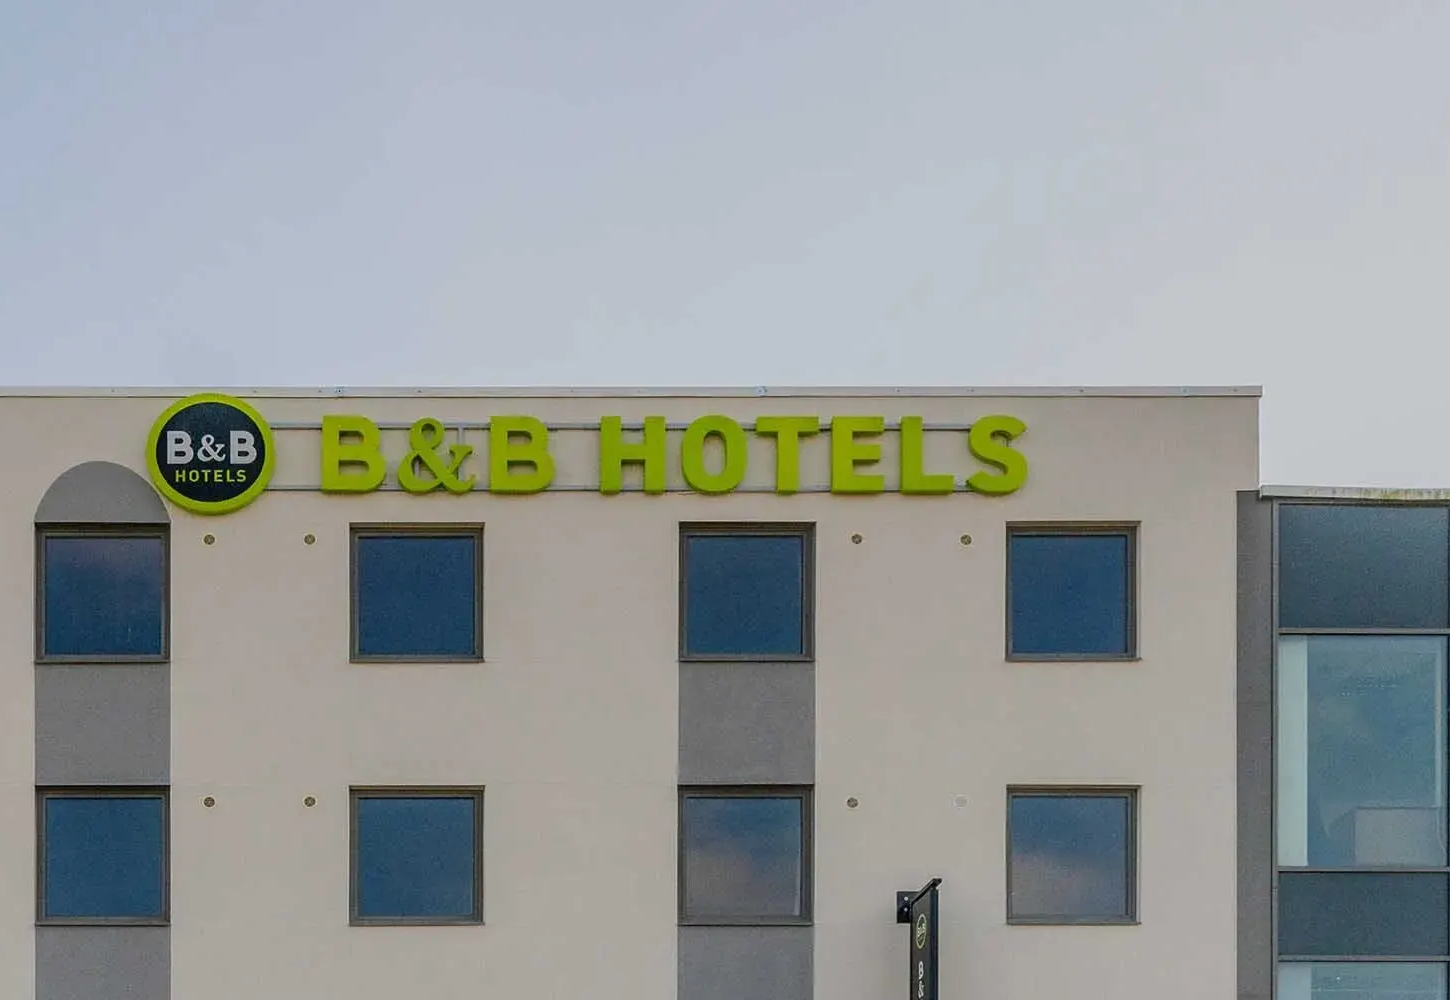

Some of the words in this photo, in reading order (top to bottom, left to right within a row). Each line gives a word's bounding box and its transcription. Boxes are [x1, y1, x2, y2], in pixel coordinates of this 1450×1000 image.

[167, 430, 257, 465] B&B
[322, 415, 556, 494] B&B
[599, 414, 1029, 496] HOTELS
[175, 469, 247, 482] HOTELS
